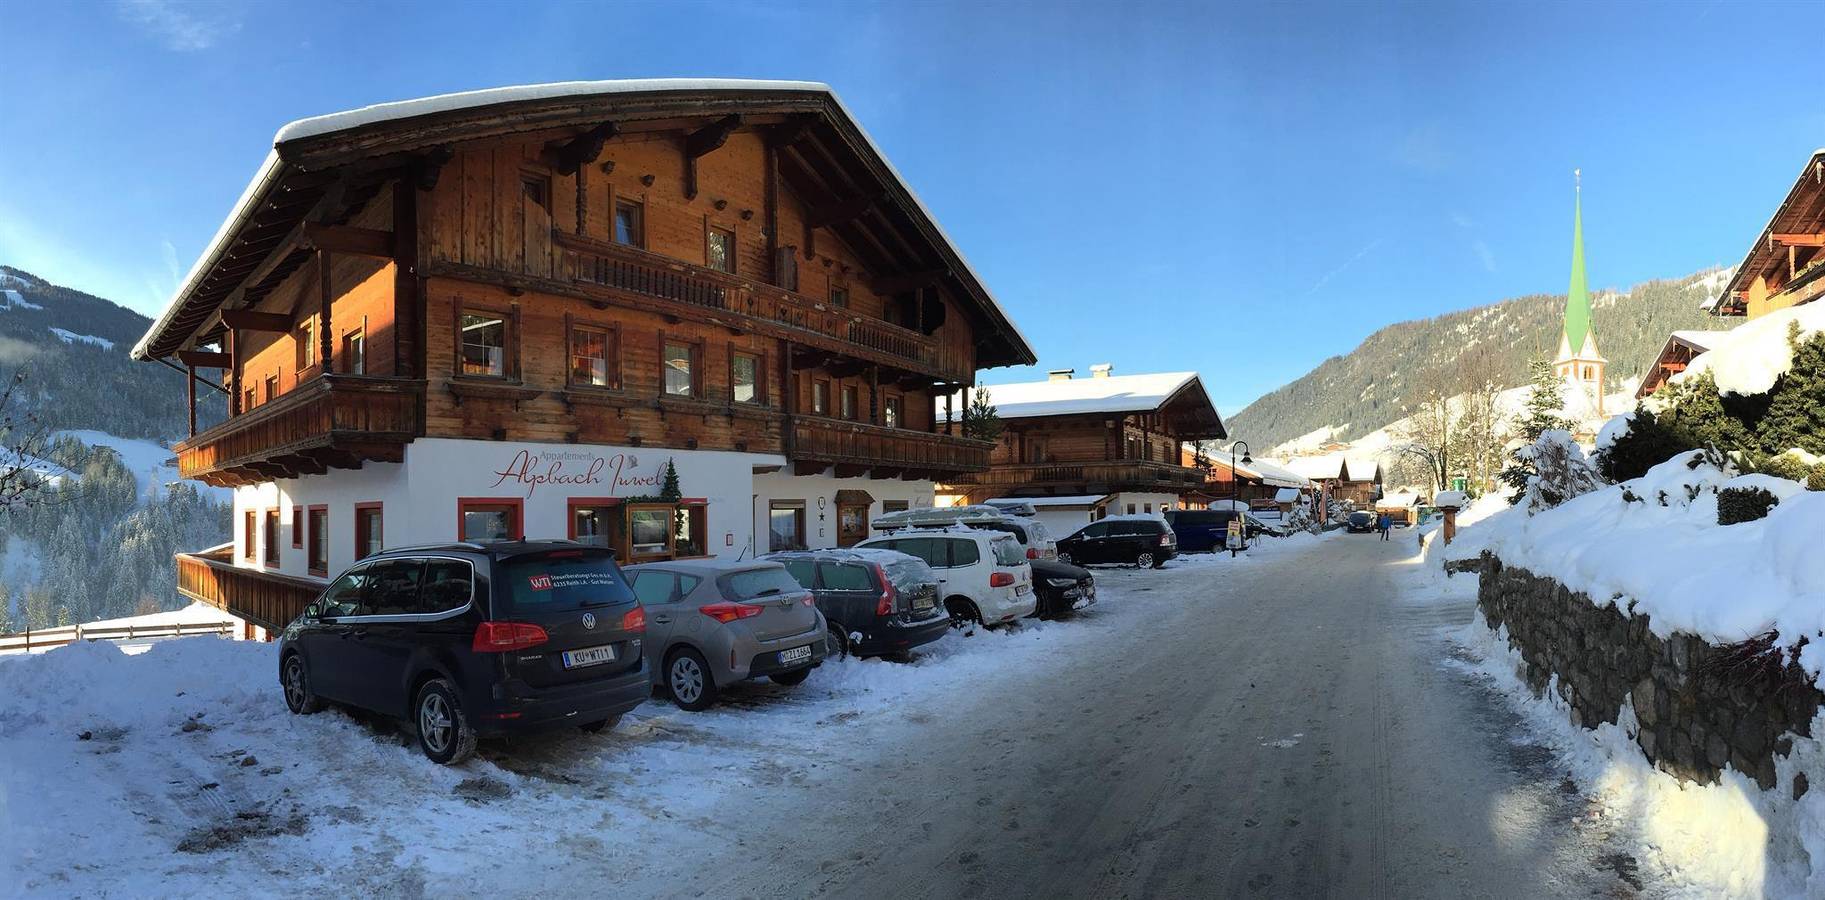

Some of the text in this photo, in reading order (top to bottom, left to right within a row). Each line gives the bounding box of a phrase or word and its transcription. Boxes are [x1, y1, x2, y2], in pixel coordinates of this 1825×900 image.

[539, 451, 595, 462] Appartements
[489, 449, 668, 500] Alpbach Juwel
[530, 577, 551, 588] WTI
